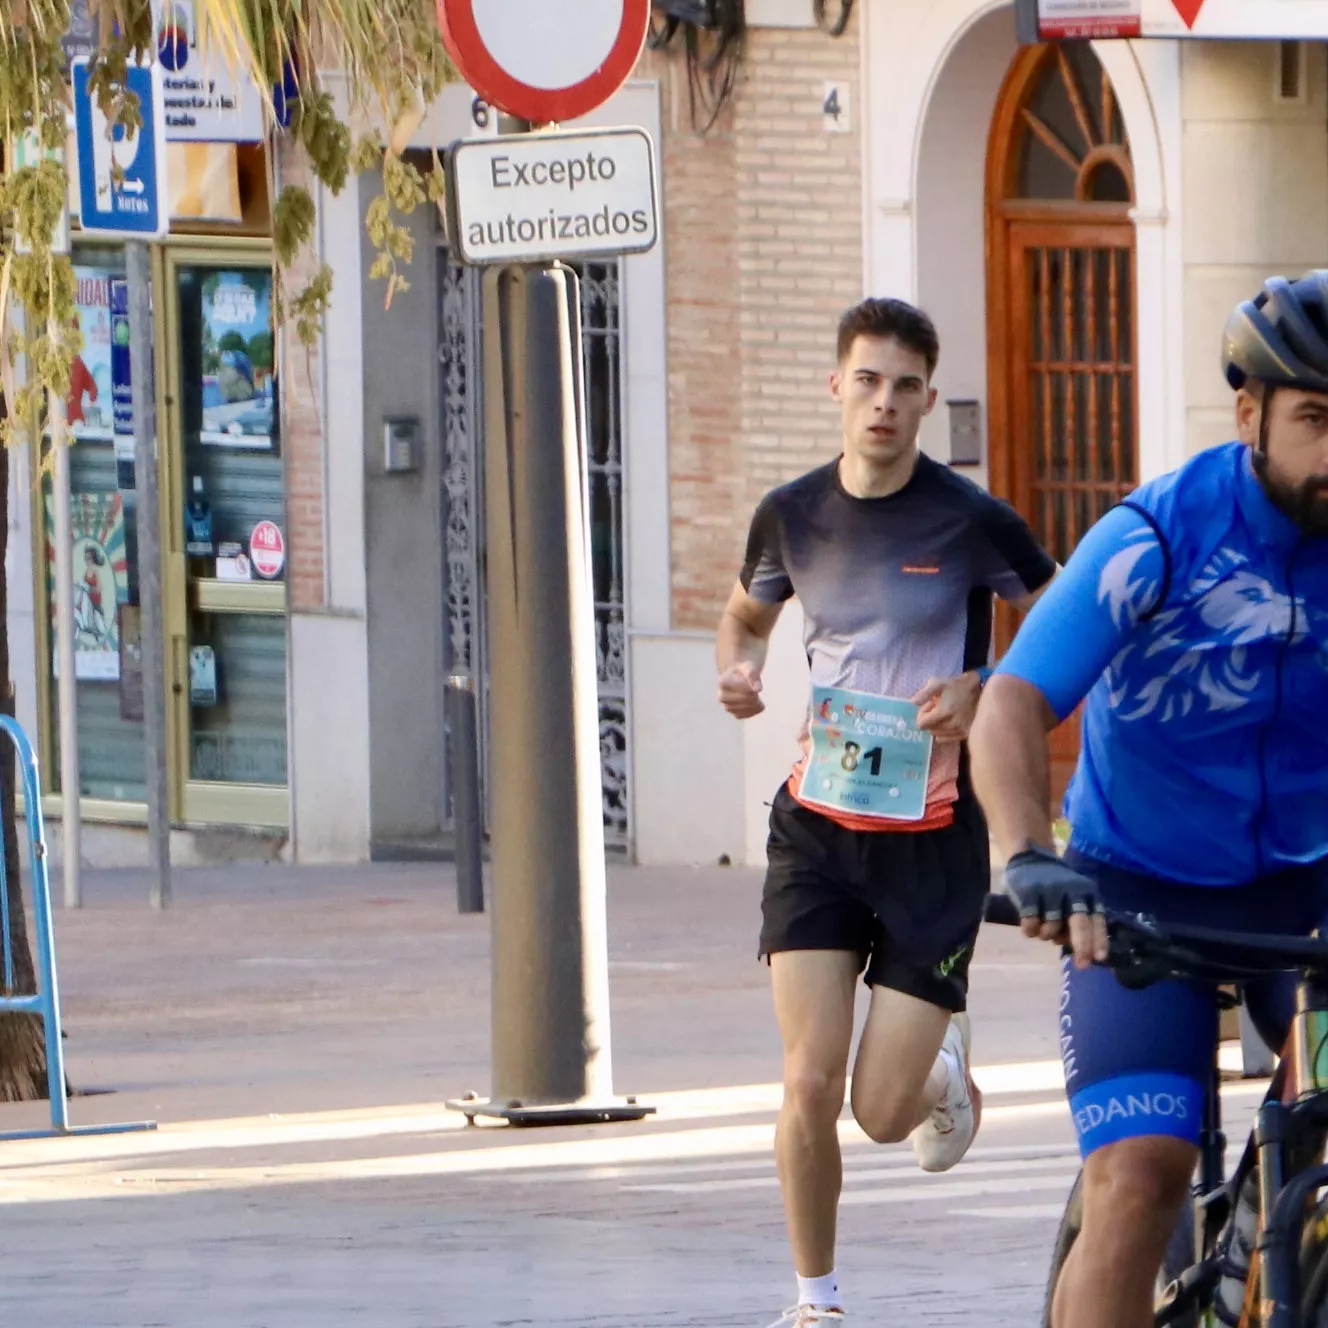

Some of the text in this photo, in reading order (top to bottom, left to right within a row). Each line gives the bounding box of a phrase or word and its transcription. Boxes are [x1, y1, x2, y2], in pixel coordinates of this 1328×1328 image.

[472, 97, 489, 127] 6
[823, 87, 842, 122] 4
[490, 152, 617, 191] Excepto
[467, 203, 650, 246] autorizados
[841, 741, 882, 776] 81
